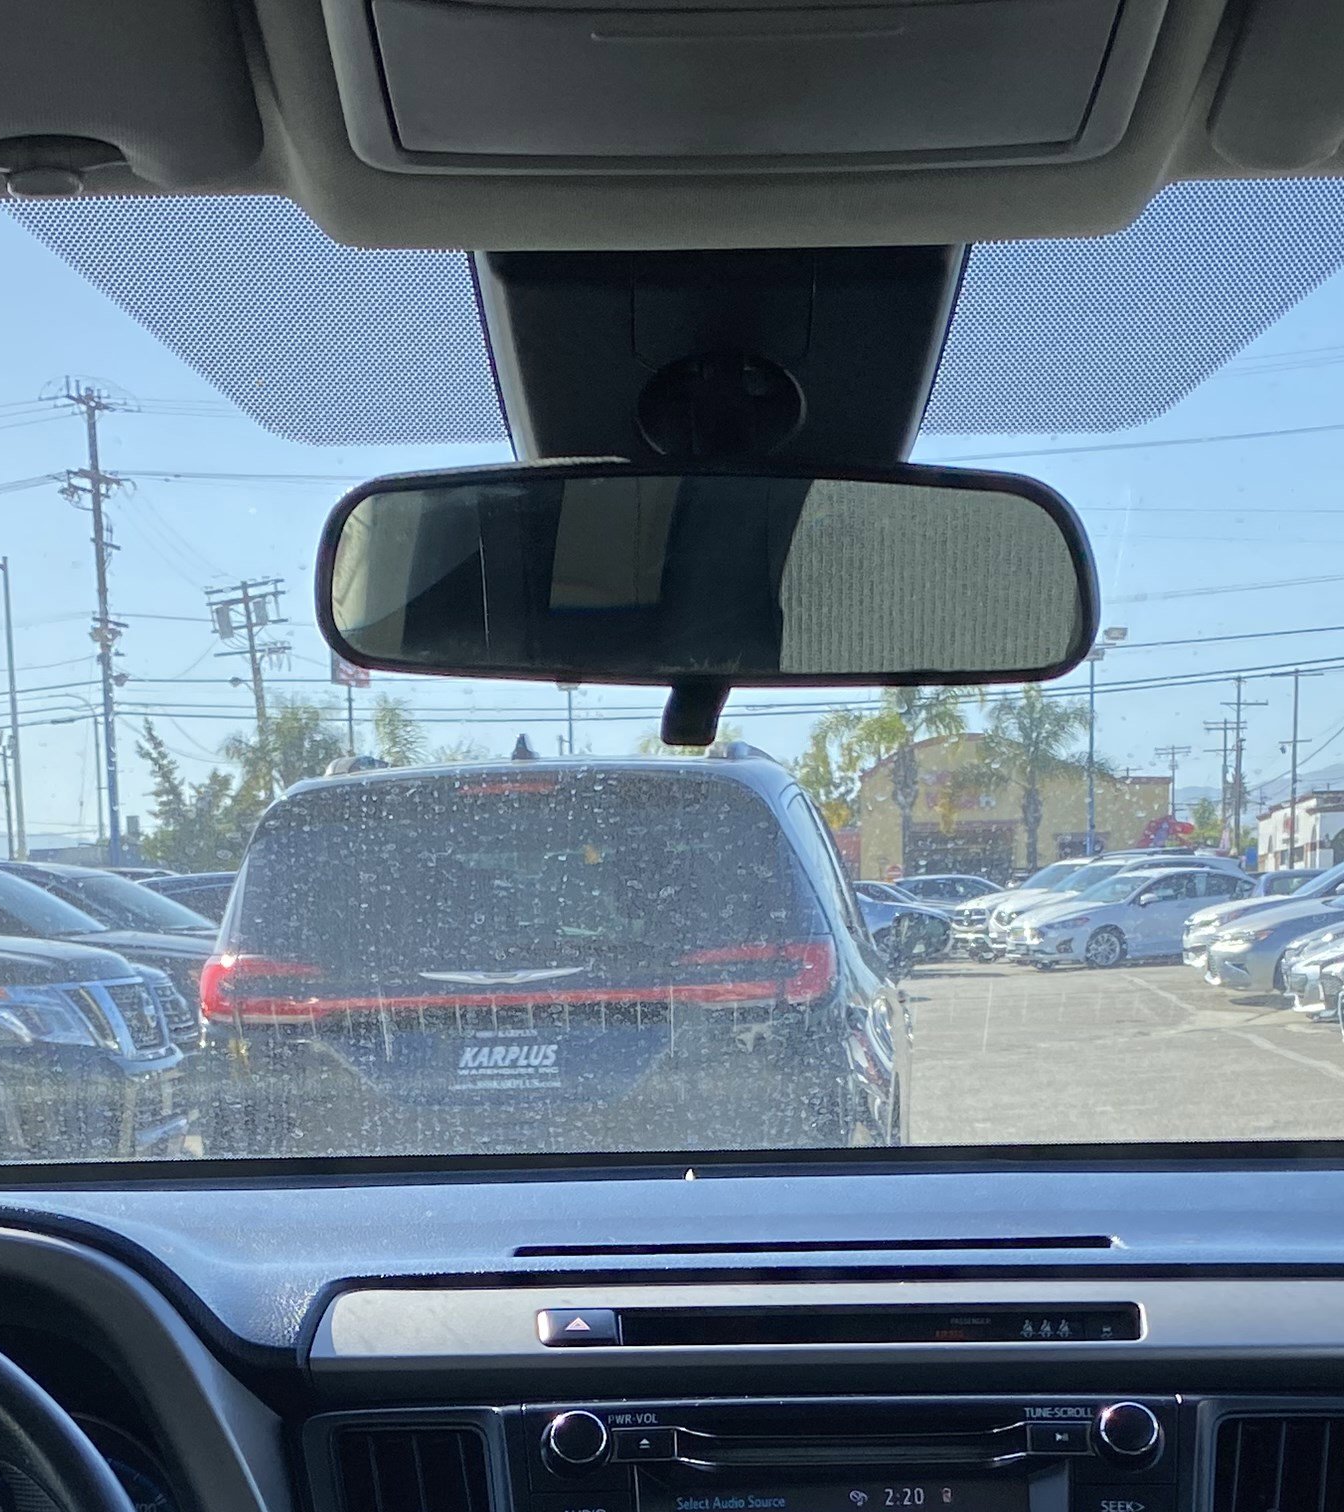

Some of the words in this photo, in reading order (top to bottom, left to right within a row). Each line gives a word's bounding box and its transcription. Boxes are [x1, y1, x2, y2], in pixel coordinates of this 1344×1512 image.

[458, 1044, 558, 1068] KARPLUS
[456, 1067, 535, 1076] WAREHOUSE
[538, 1066, 559, 1074] INC
[676, 1496, 710, 1511] Select
[712, 1495, 745, 1510] Audio
[746, 1495, 786, 1509] Source
[883, 1487, 924, 1506] 2:20
